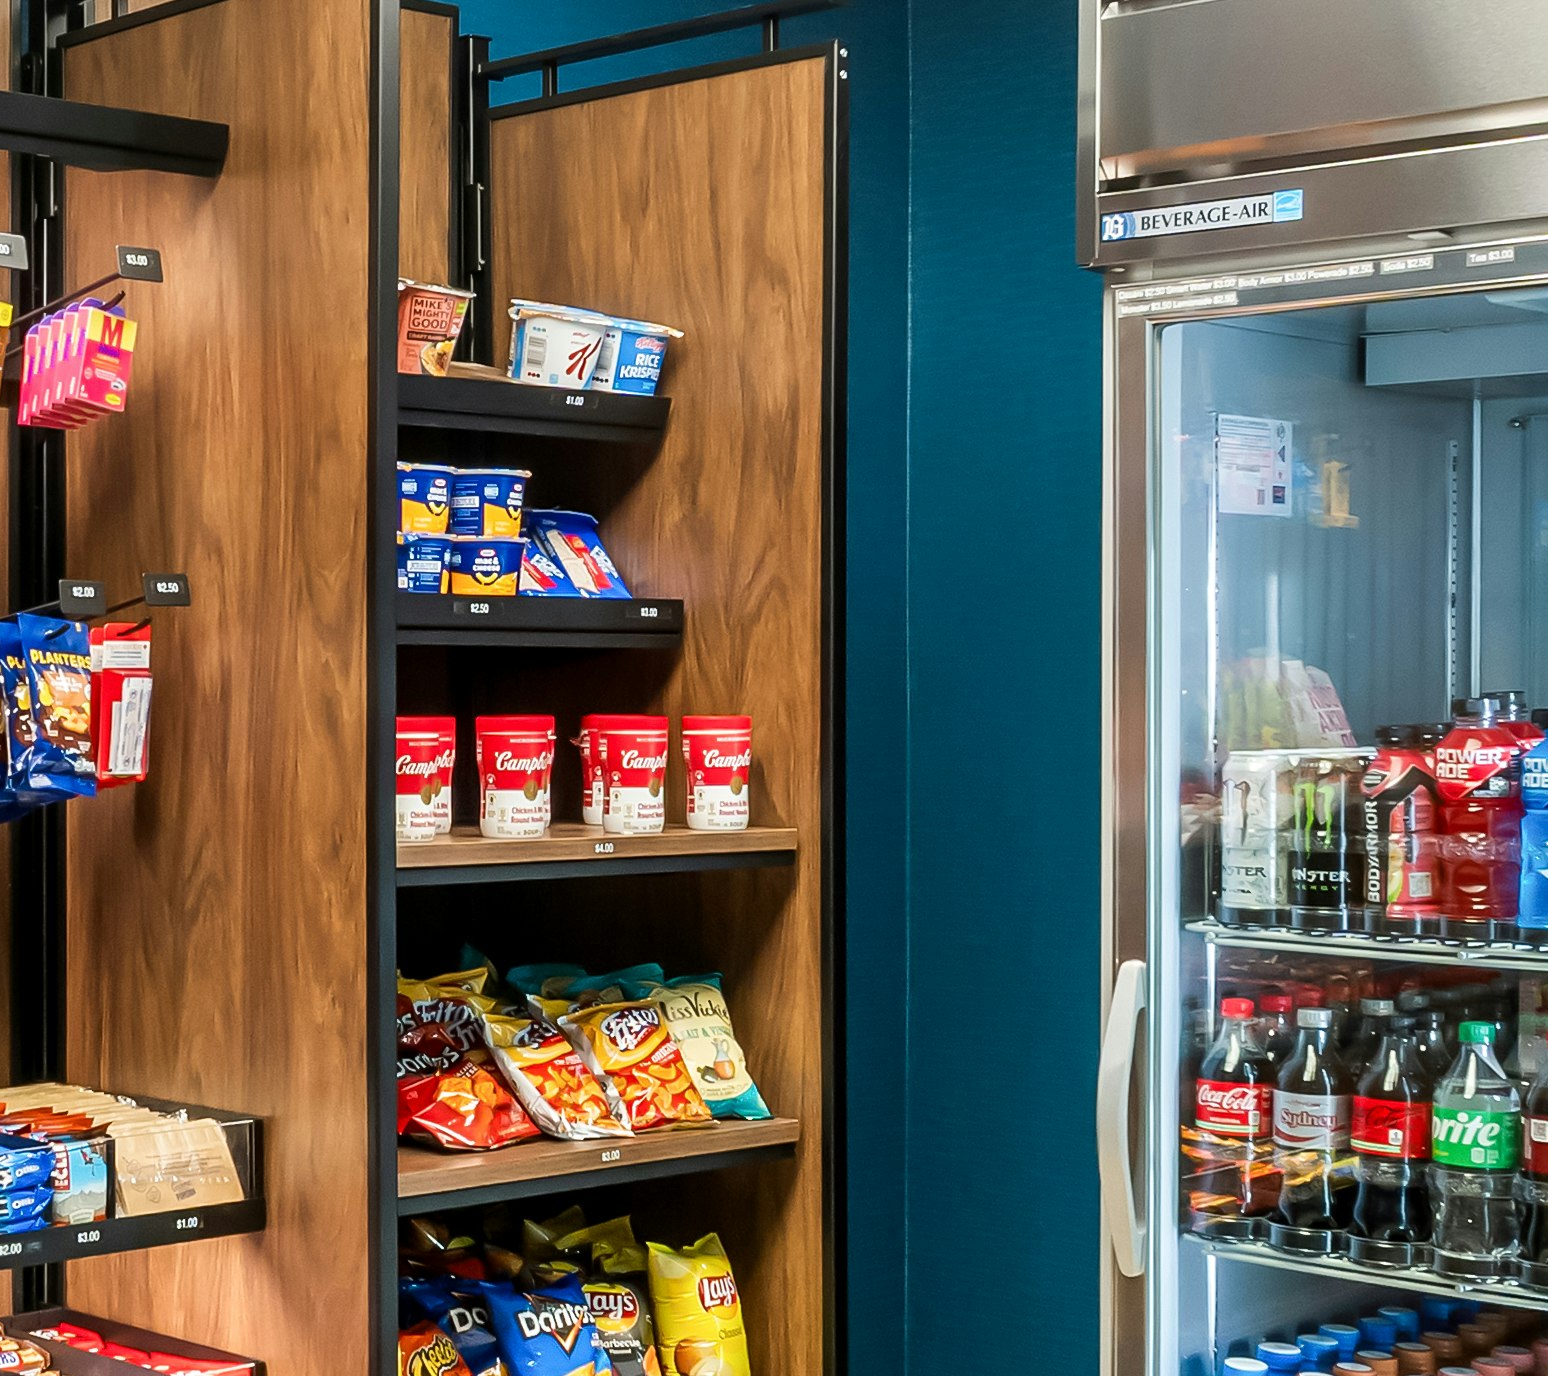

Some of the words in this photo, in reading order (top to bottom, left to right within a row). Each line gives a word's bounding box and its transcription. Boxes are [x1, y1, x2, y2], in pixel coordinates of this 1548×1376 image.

[1139, 202, 1269, 233] BEVERAGE-AIR
[414, 298, 452, 312] MIKE'S
[413, 310, 450, 320] MIGHTY
[413, 318, 448, 330] GOOD
[636, 353, 658, 368] RICE
[30, 649, 91, 669] PLANTERS
[1435, 748, 1502, 766] POWER
[1436, 763, 1469, 780] ADE
[1365, 801, 1380, 903] BODYARMOR
[176, 1217, 198, 1229] $1.00
[702, 1276, 736, 1308] Lay's
[519, 1304, 594, 1338] Doritos
